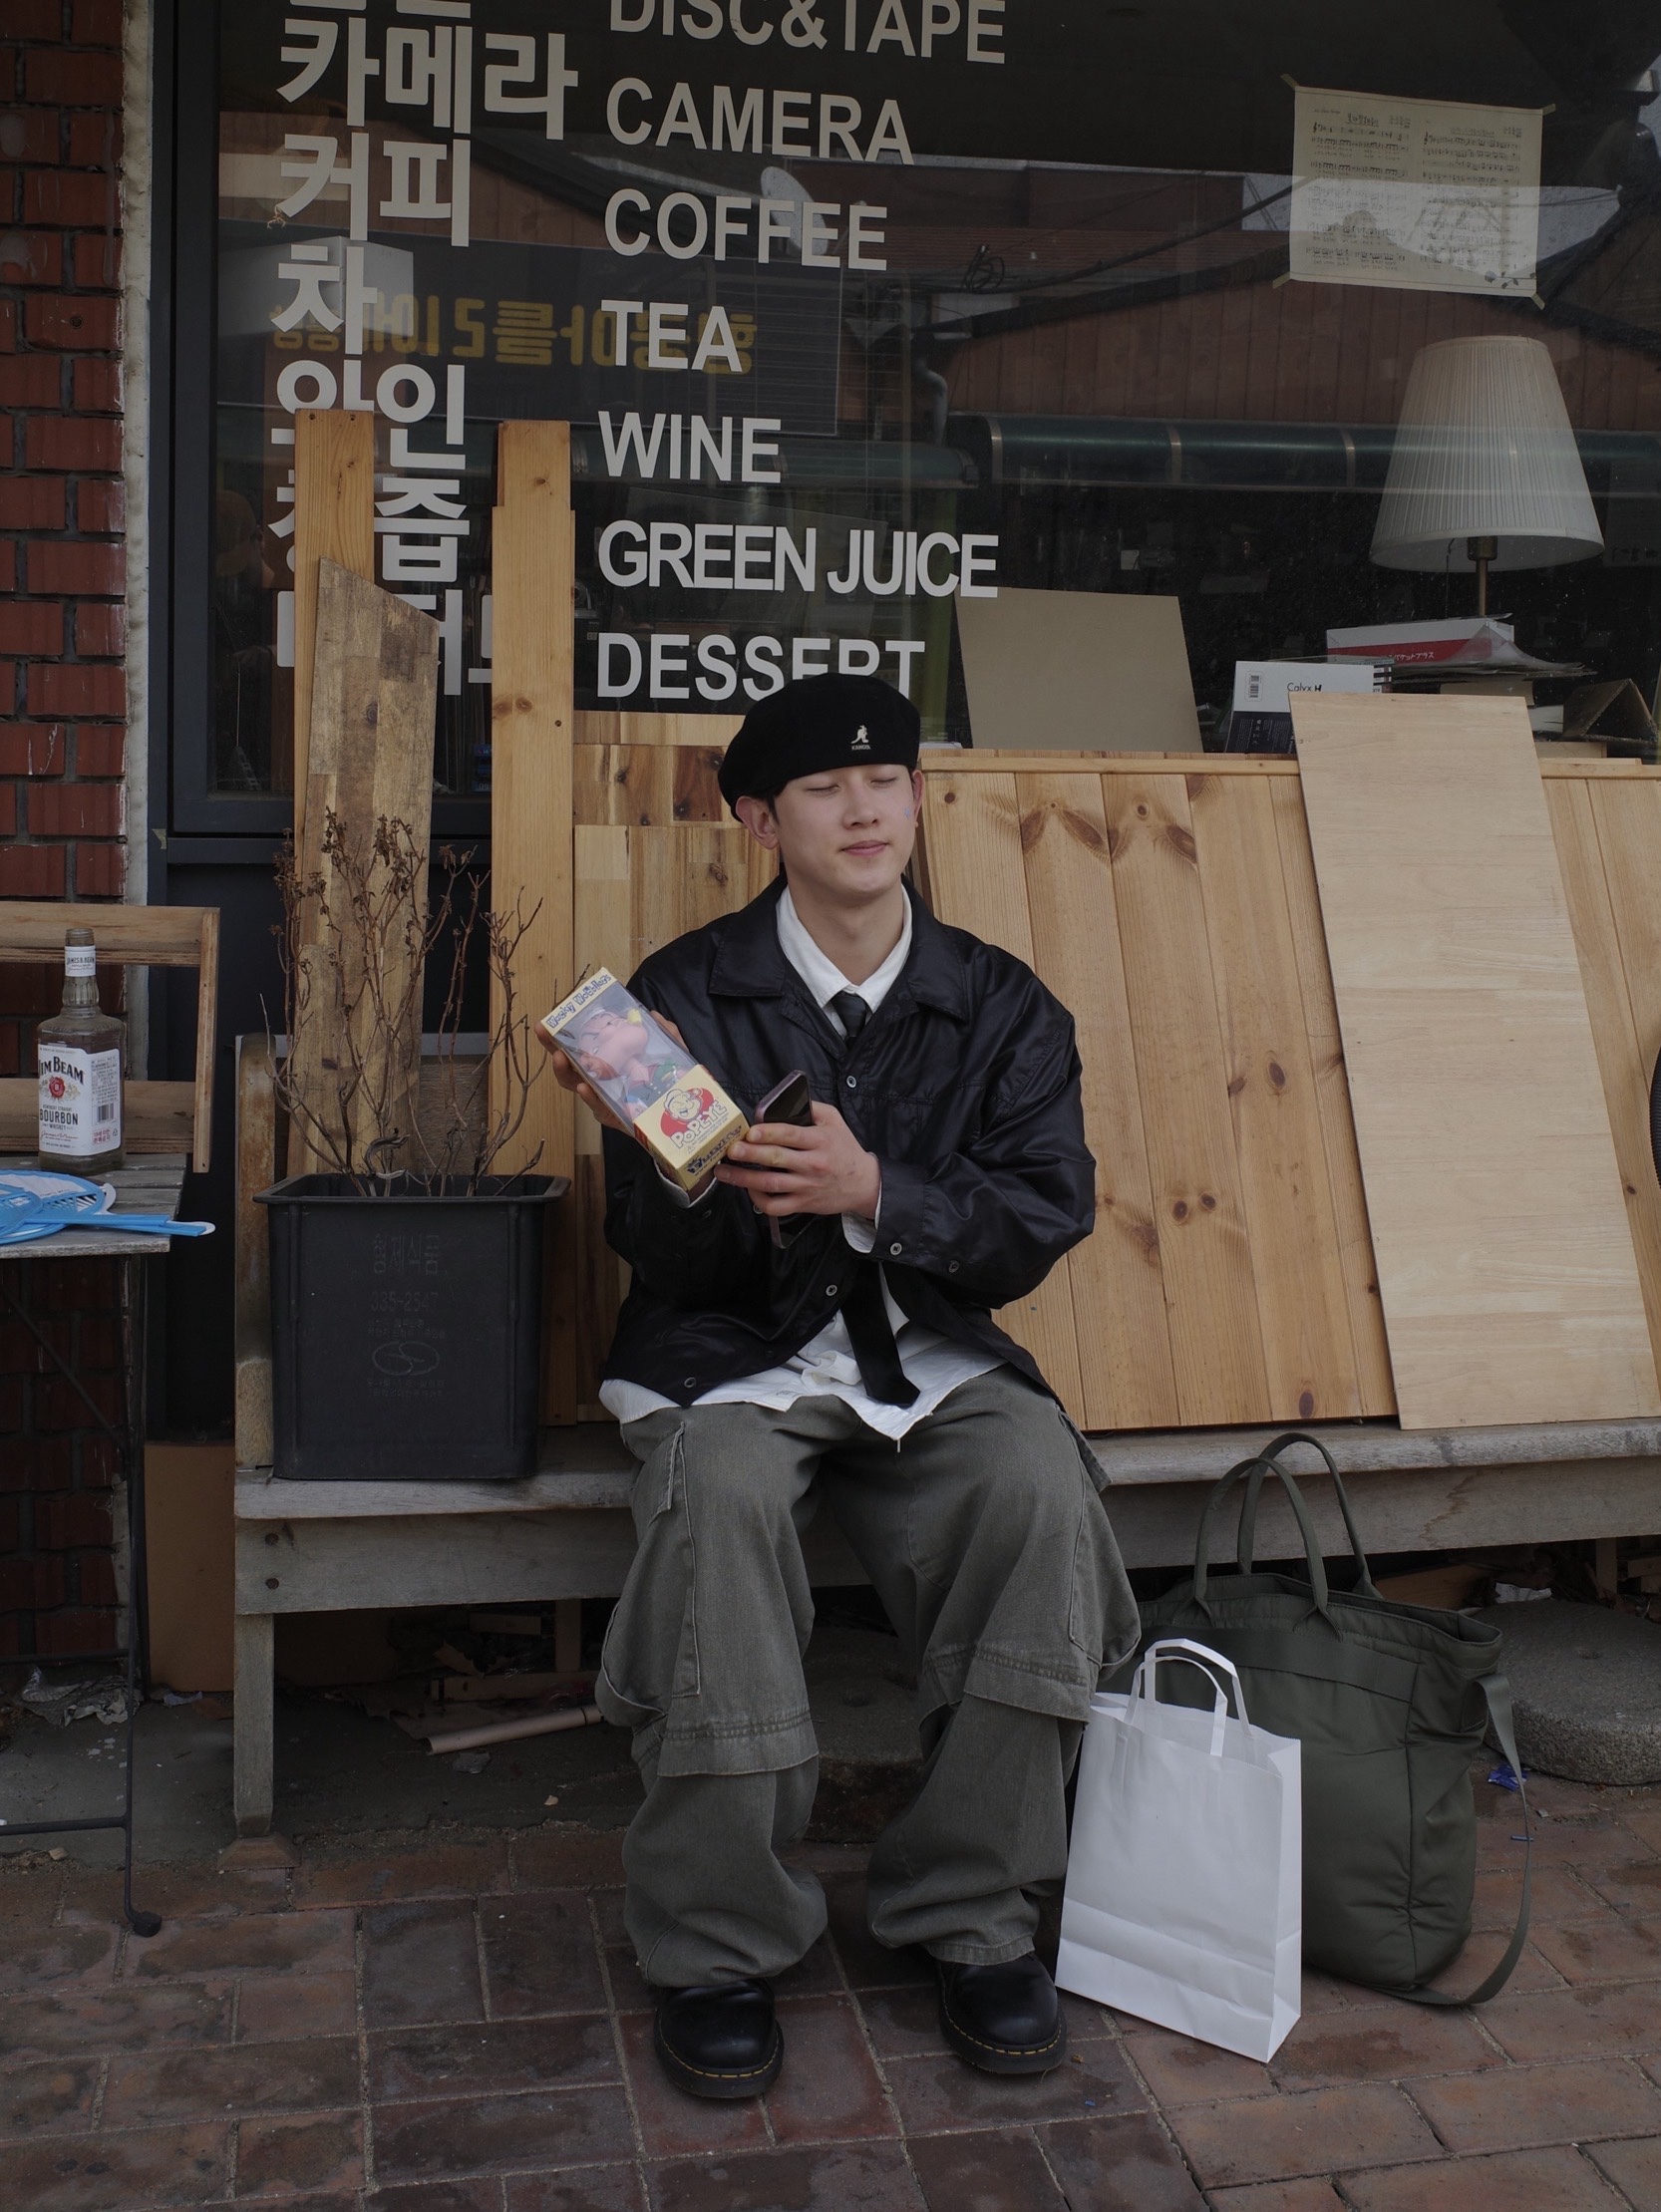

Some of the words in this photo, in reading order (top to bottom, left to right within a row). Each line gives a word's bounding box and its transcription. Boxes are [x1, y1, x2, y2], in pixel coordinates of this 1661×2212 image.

[276, 17, 578, 141] 카메라
[604, 76, 915, 166] CAMERA
[274, 132, 471, 248] 커피
[603, 187, 888, 272] COFFEE
[271, 245, 377, 355] 차
[599, 298, 744, 374] TEA
[598, 410, 783, 485] WINE
[268, 469, 470, 583] 즙
[597, 519, 818, 594] GREEN
[827, 527, 1000, 599] JUICE
[53, 1056, 85, 1086] BEAM
[40, 1108, 79, 1125] BOURBON
